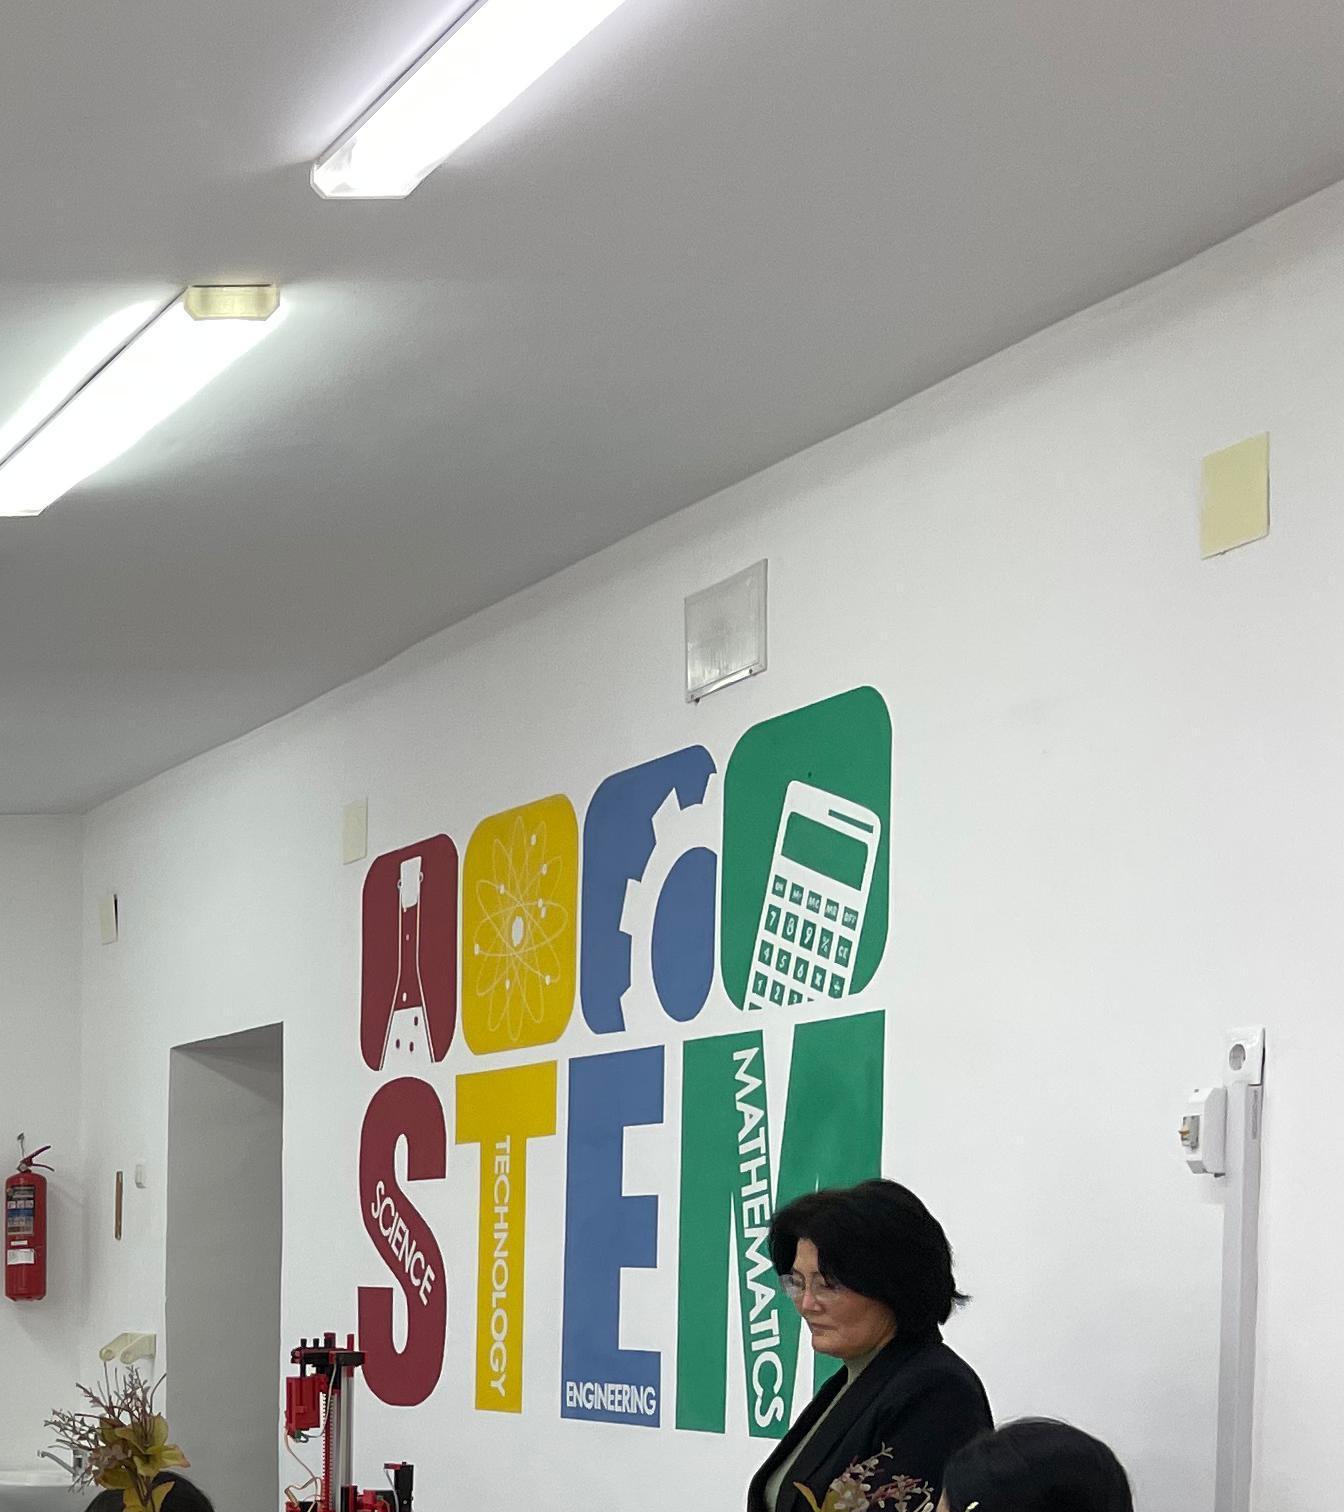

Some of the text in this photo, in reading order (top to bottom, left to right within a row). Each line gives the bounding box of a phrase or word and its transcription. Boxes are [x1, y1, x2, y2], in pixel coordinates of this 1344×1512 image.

[786, 918, 795, 937] 8
[803, 926, 813, 945] 9
[358, 1009, 886, 1438] STEM
[370, 1180, 436, 1306] SCIENCE
[489, 1135, 511, 1398] TECHNOLOGY
[732, 1046, 785, 1428] MATHEMATICS
[566, 1381, 657, 1416] ENGINEERING
